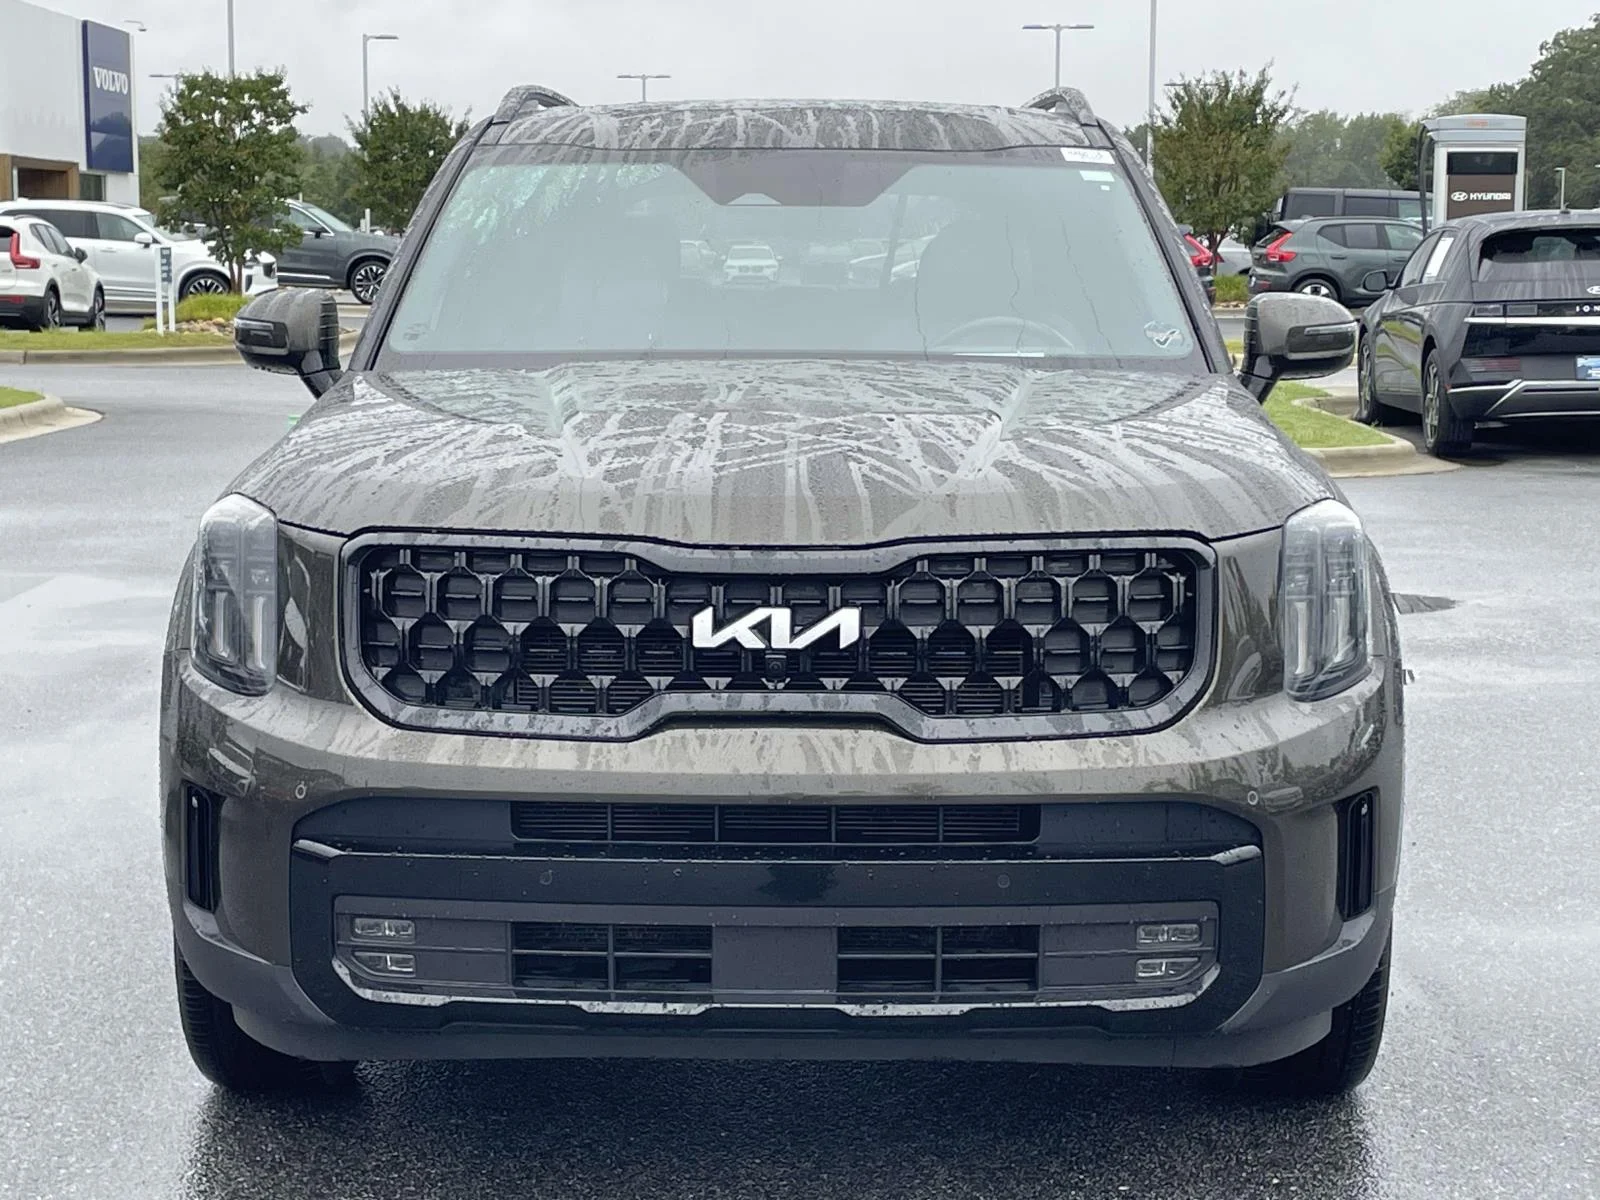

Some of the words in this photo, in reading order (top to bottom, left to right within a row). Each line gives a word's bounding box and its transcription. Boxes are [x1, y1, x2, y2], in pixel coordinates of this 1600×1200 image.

[93, 66, 129, 95] VOLVO
[1469, 192, 1512, 201] HYUNDAI
[692, 606, 861, 650] KIA
